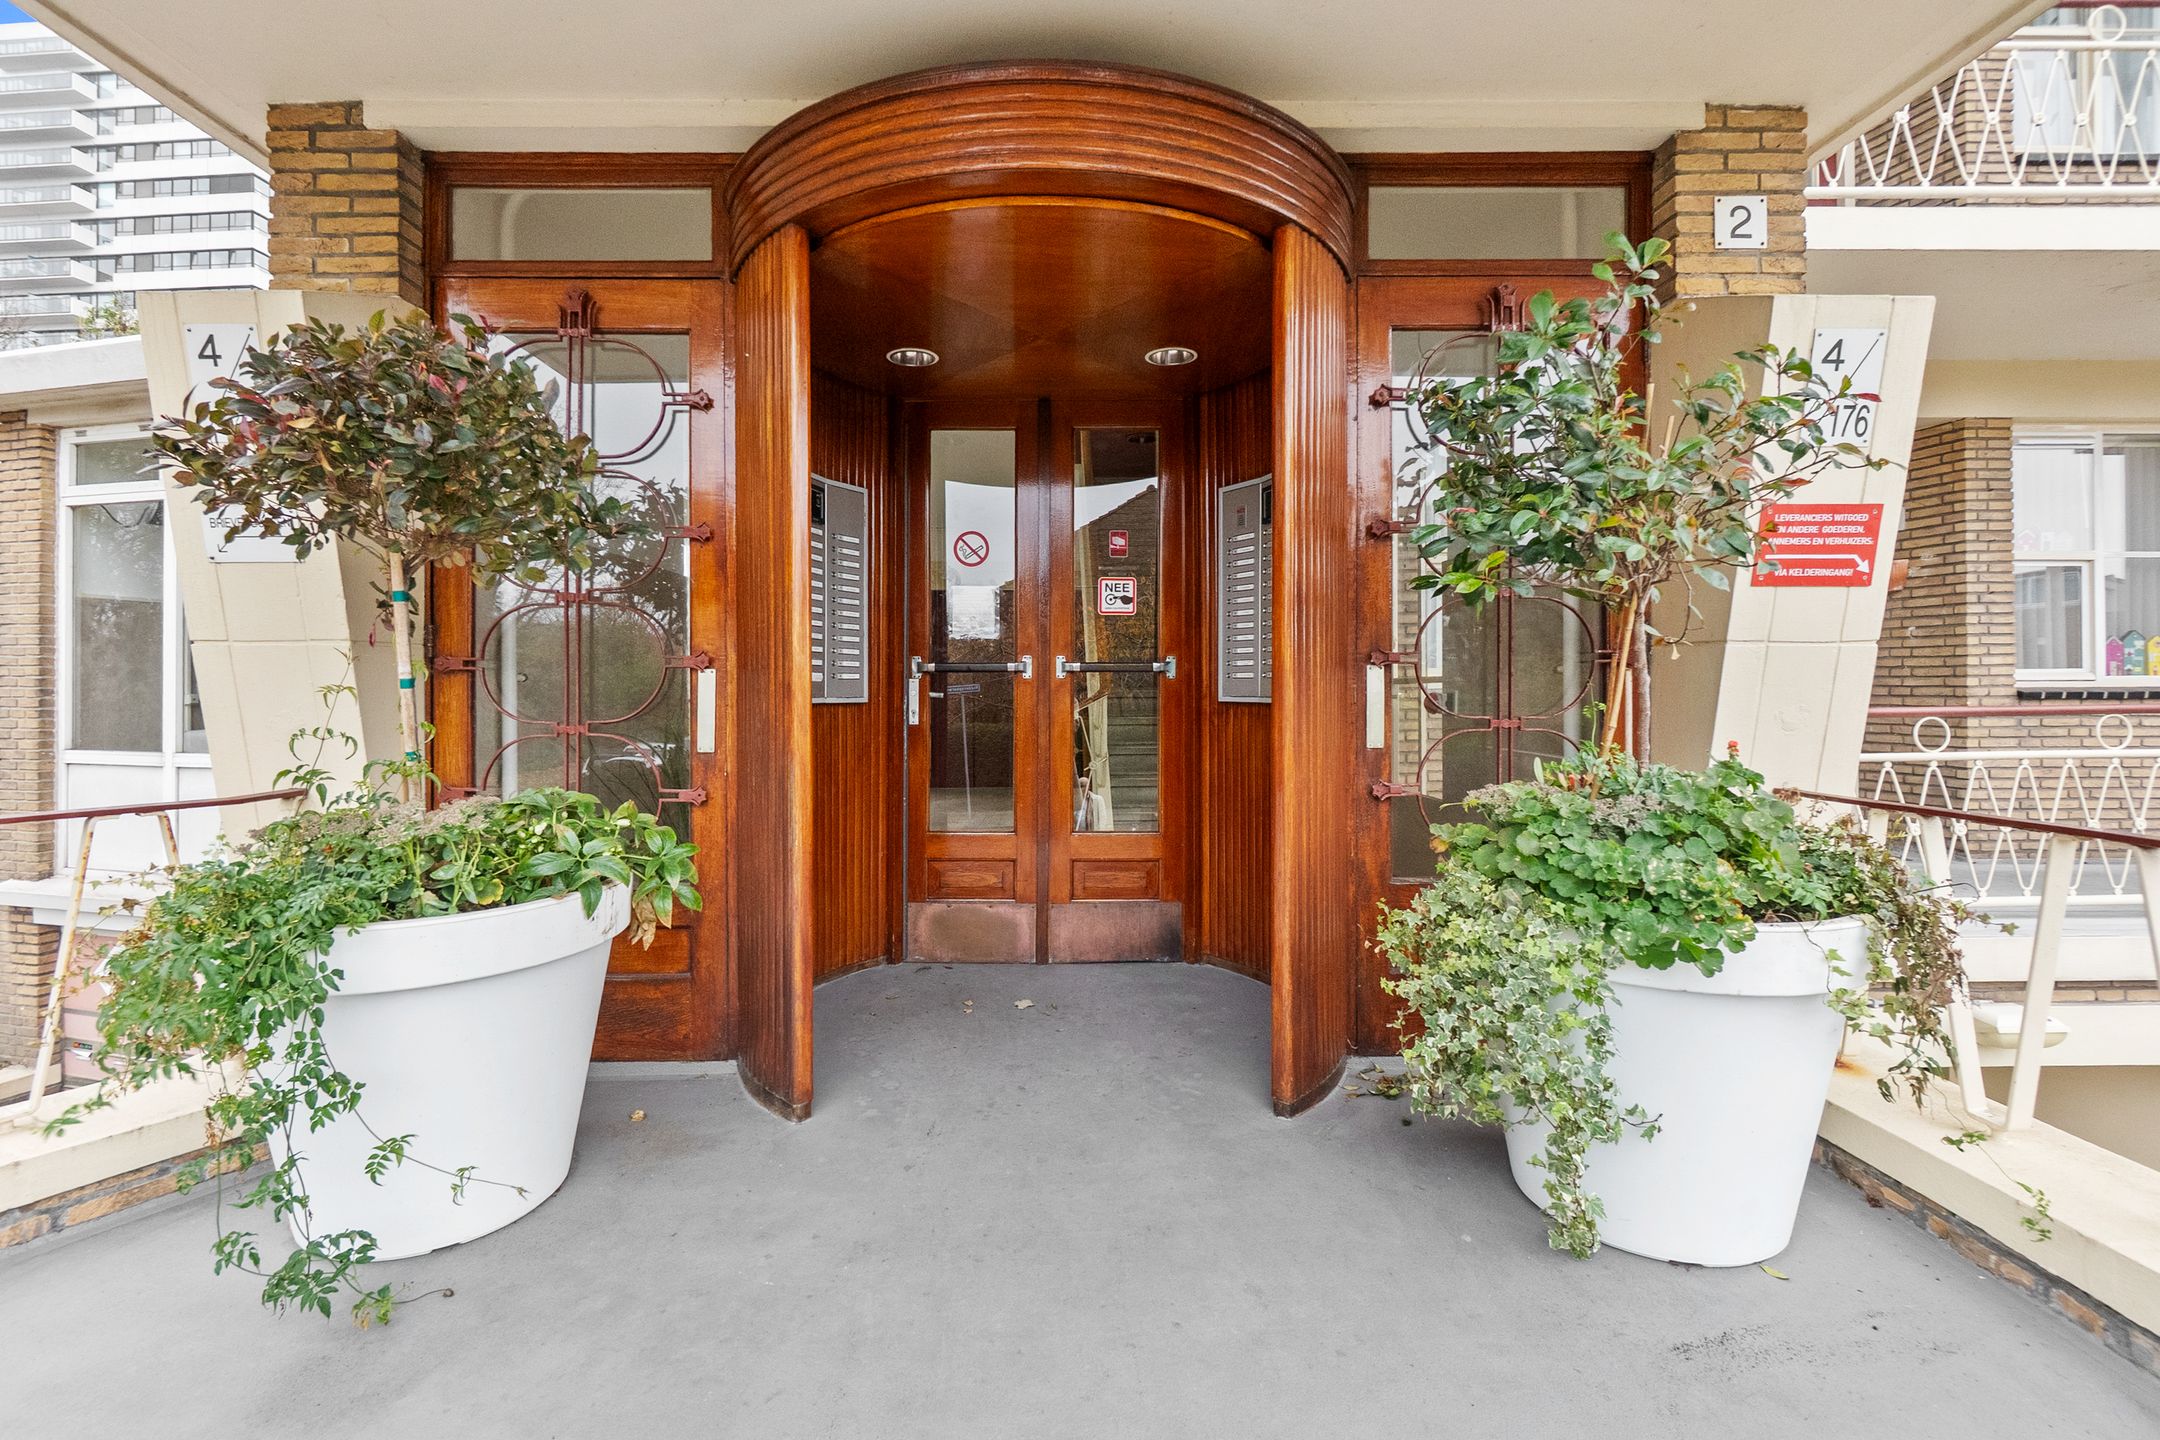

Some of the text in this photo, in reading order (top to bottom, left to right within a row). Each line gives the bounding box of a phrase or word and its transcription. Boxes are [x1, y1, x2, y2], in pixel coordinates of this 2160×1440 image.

[1730, 205, 1752, 238] 2
[197, 334, 222, 367] 4
[1821, 338, 1845, 371] 4
[1831, 404, 1870, 437] 176
[1774, 513, 1869, 522] LEVERANCIERS WITGOED
[1786, 525, 1819, 534] ANDERE
[1811, 537, 1825, 546] EN
[1104, 582, 1130, 593] NEE
